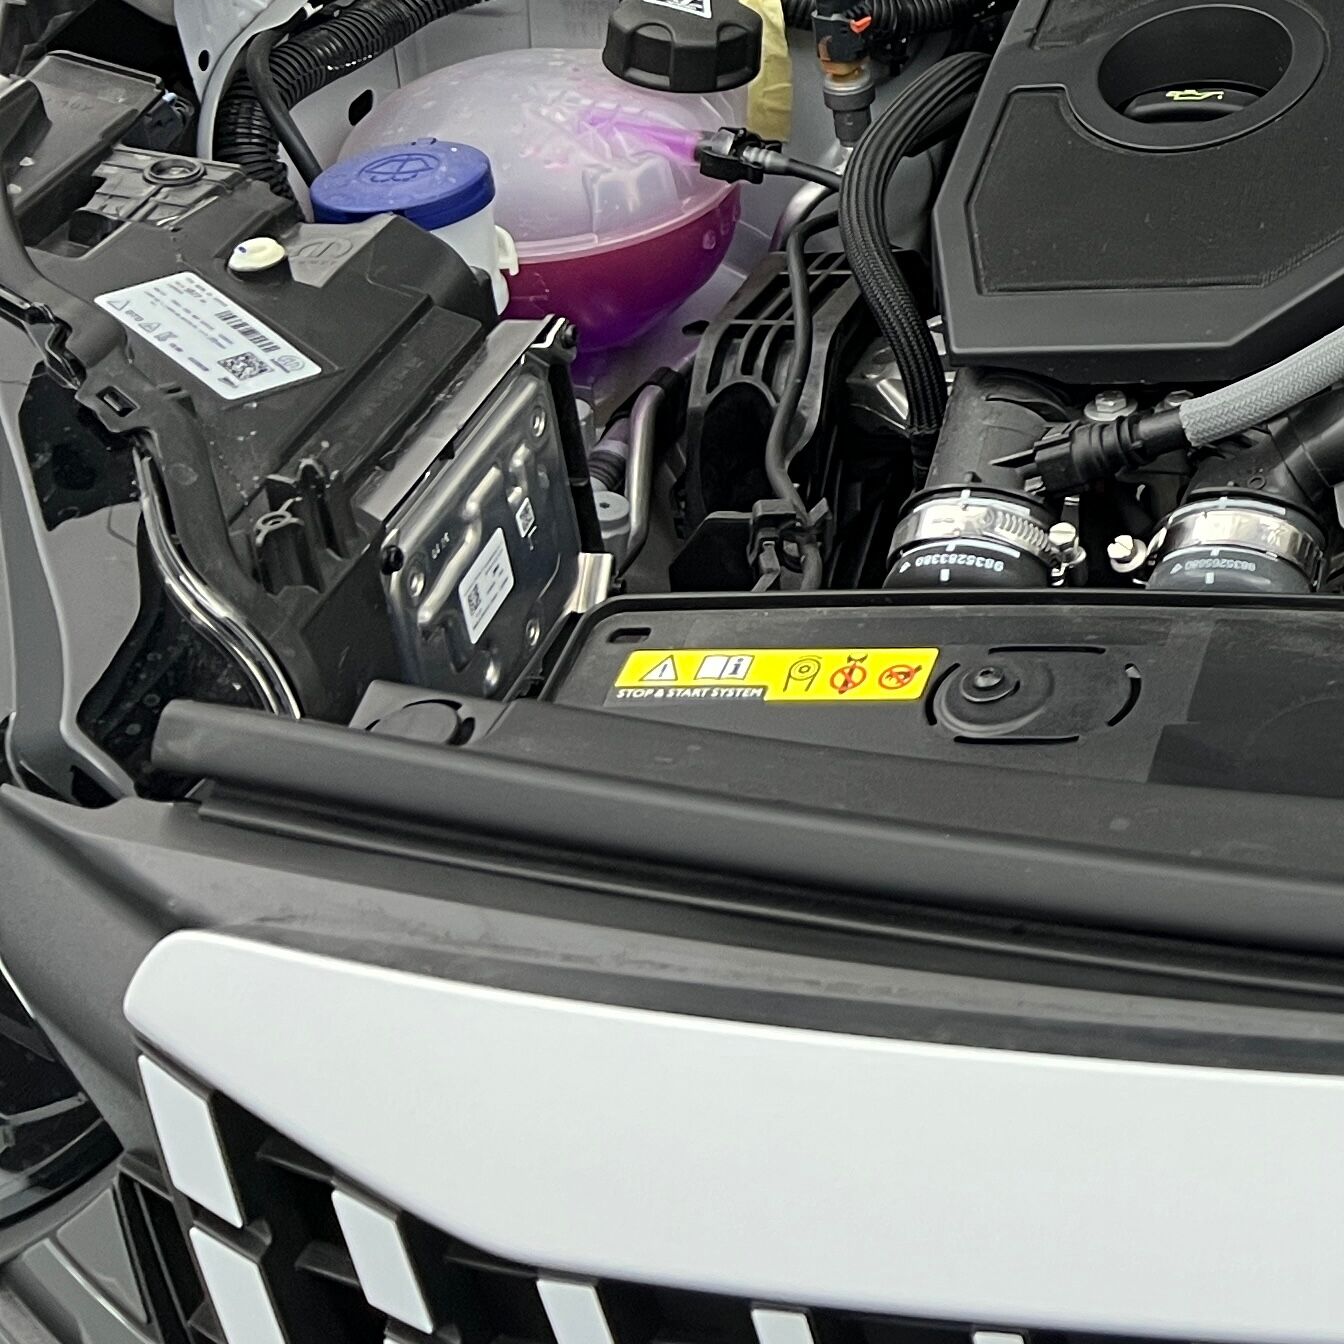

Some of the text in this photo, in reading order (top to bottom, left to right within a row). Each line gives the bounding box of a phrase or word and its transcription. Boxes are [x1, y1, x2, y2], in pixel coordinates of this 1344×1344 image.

[616, 687, 764, 698] STOP & START SYSTEM
